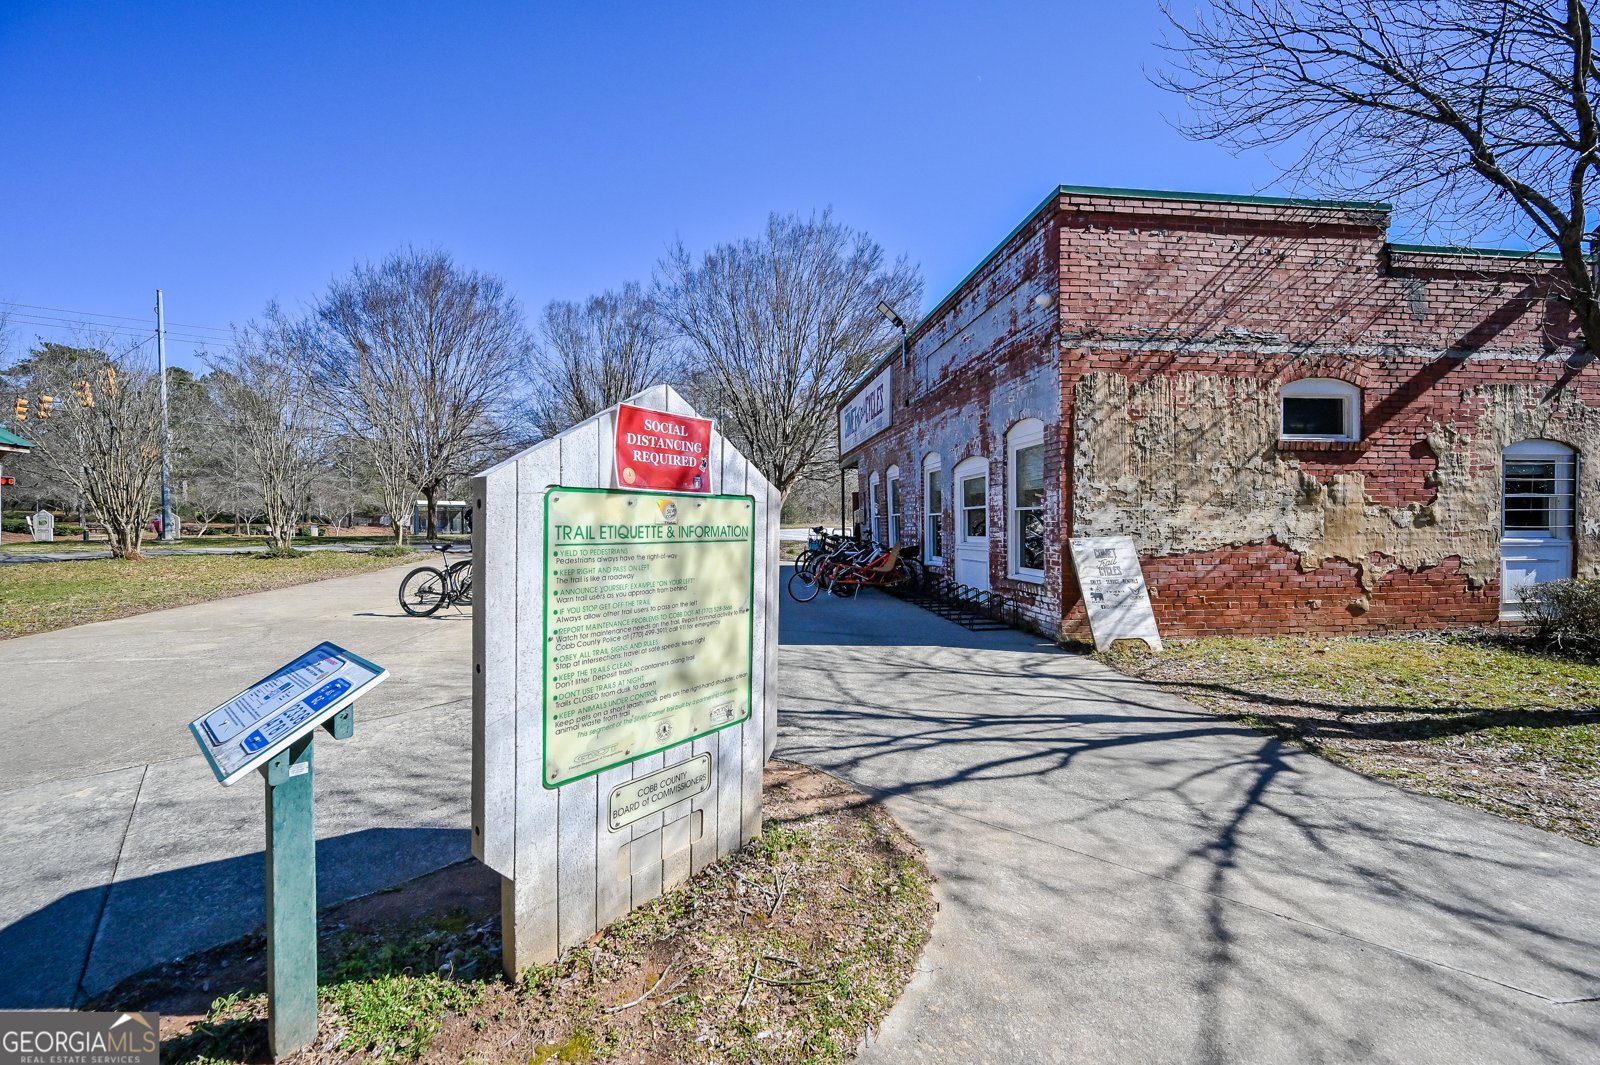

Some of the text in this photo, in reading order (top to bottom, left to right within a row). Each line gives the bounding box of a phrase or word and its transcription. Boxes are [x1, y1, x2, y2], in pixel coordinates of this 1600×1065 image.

[644, 419, 688, 436] SOCIAL
[626, 432, 702, 453] DISTANCING
[633, 450, 696, 467] REQUIRED
[555, 524, 748, 540] TRAIL ETIQUETTE & INFORMATION
[560, 587, 598, 595] ANNOUNCE
[628, 588, 656, 597] approach
[556, 634, 578, 643] Watch
[591, 626, 631, 637] maintenance
[633, 623, 651, 631] needs
[558, 626, 584, 635] REPORT
[586, 619, 630, 631] MAINTENANCE
[631, 614, 659, 624] PROBLEMS
[556, 642, 575, 651] Cobb
[577, 639, 600, 648] County
[559, 654, 577, 662] OBEY
[593, 649, 608, 657] TRAIL
[611, 645, 628, 653] SIGNS
[556, 681, 574, 689] Don't
[592, 673, 618, 682] Deposit
[641, 661, 669, 671] containers
[559, 672, 574, 680] KEEP
[590, 665, 610, 674] TRAILS
[612, 661, 633, 670] CLEAN
[559, 690, 580, 700] DON'T
[596, 682, 616, 691] TRAILS
[627, 675, 644, 683] NIGHT
[574, 693, 599, 704] CLOSED
[640, 680, 656, 688] dawn
[559, 690, 657, 719] KEEP ANIMALS UNDER CONTROL
[555, 719, 574, 728] Keep
[576, 714, 591, 723] pets
[610, 705, 625, 714] short
[555, 724, 580, 735] animal
[582, 718, 601, 728] waste
[589, 724, 615, 734] segment
[638, 771, 687, 798] COBB COUNTY
[613, 773, 707, 819] BOARD of COMMISSIONERS
